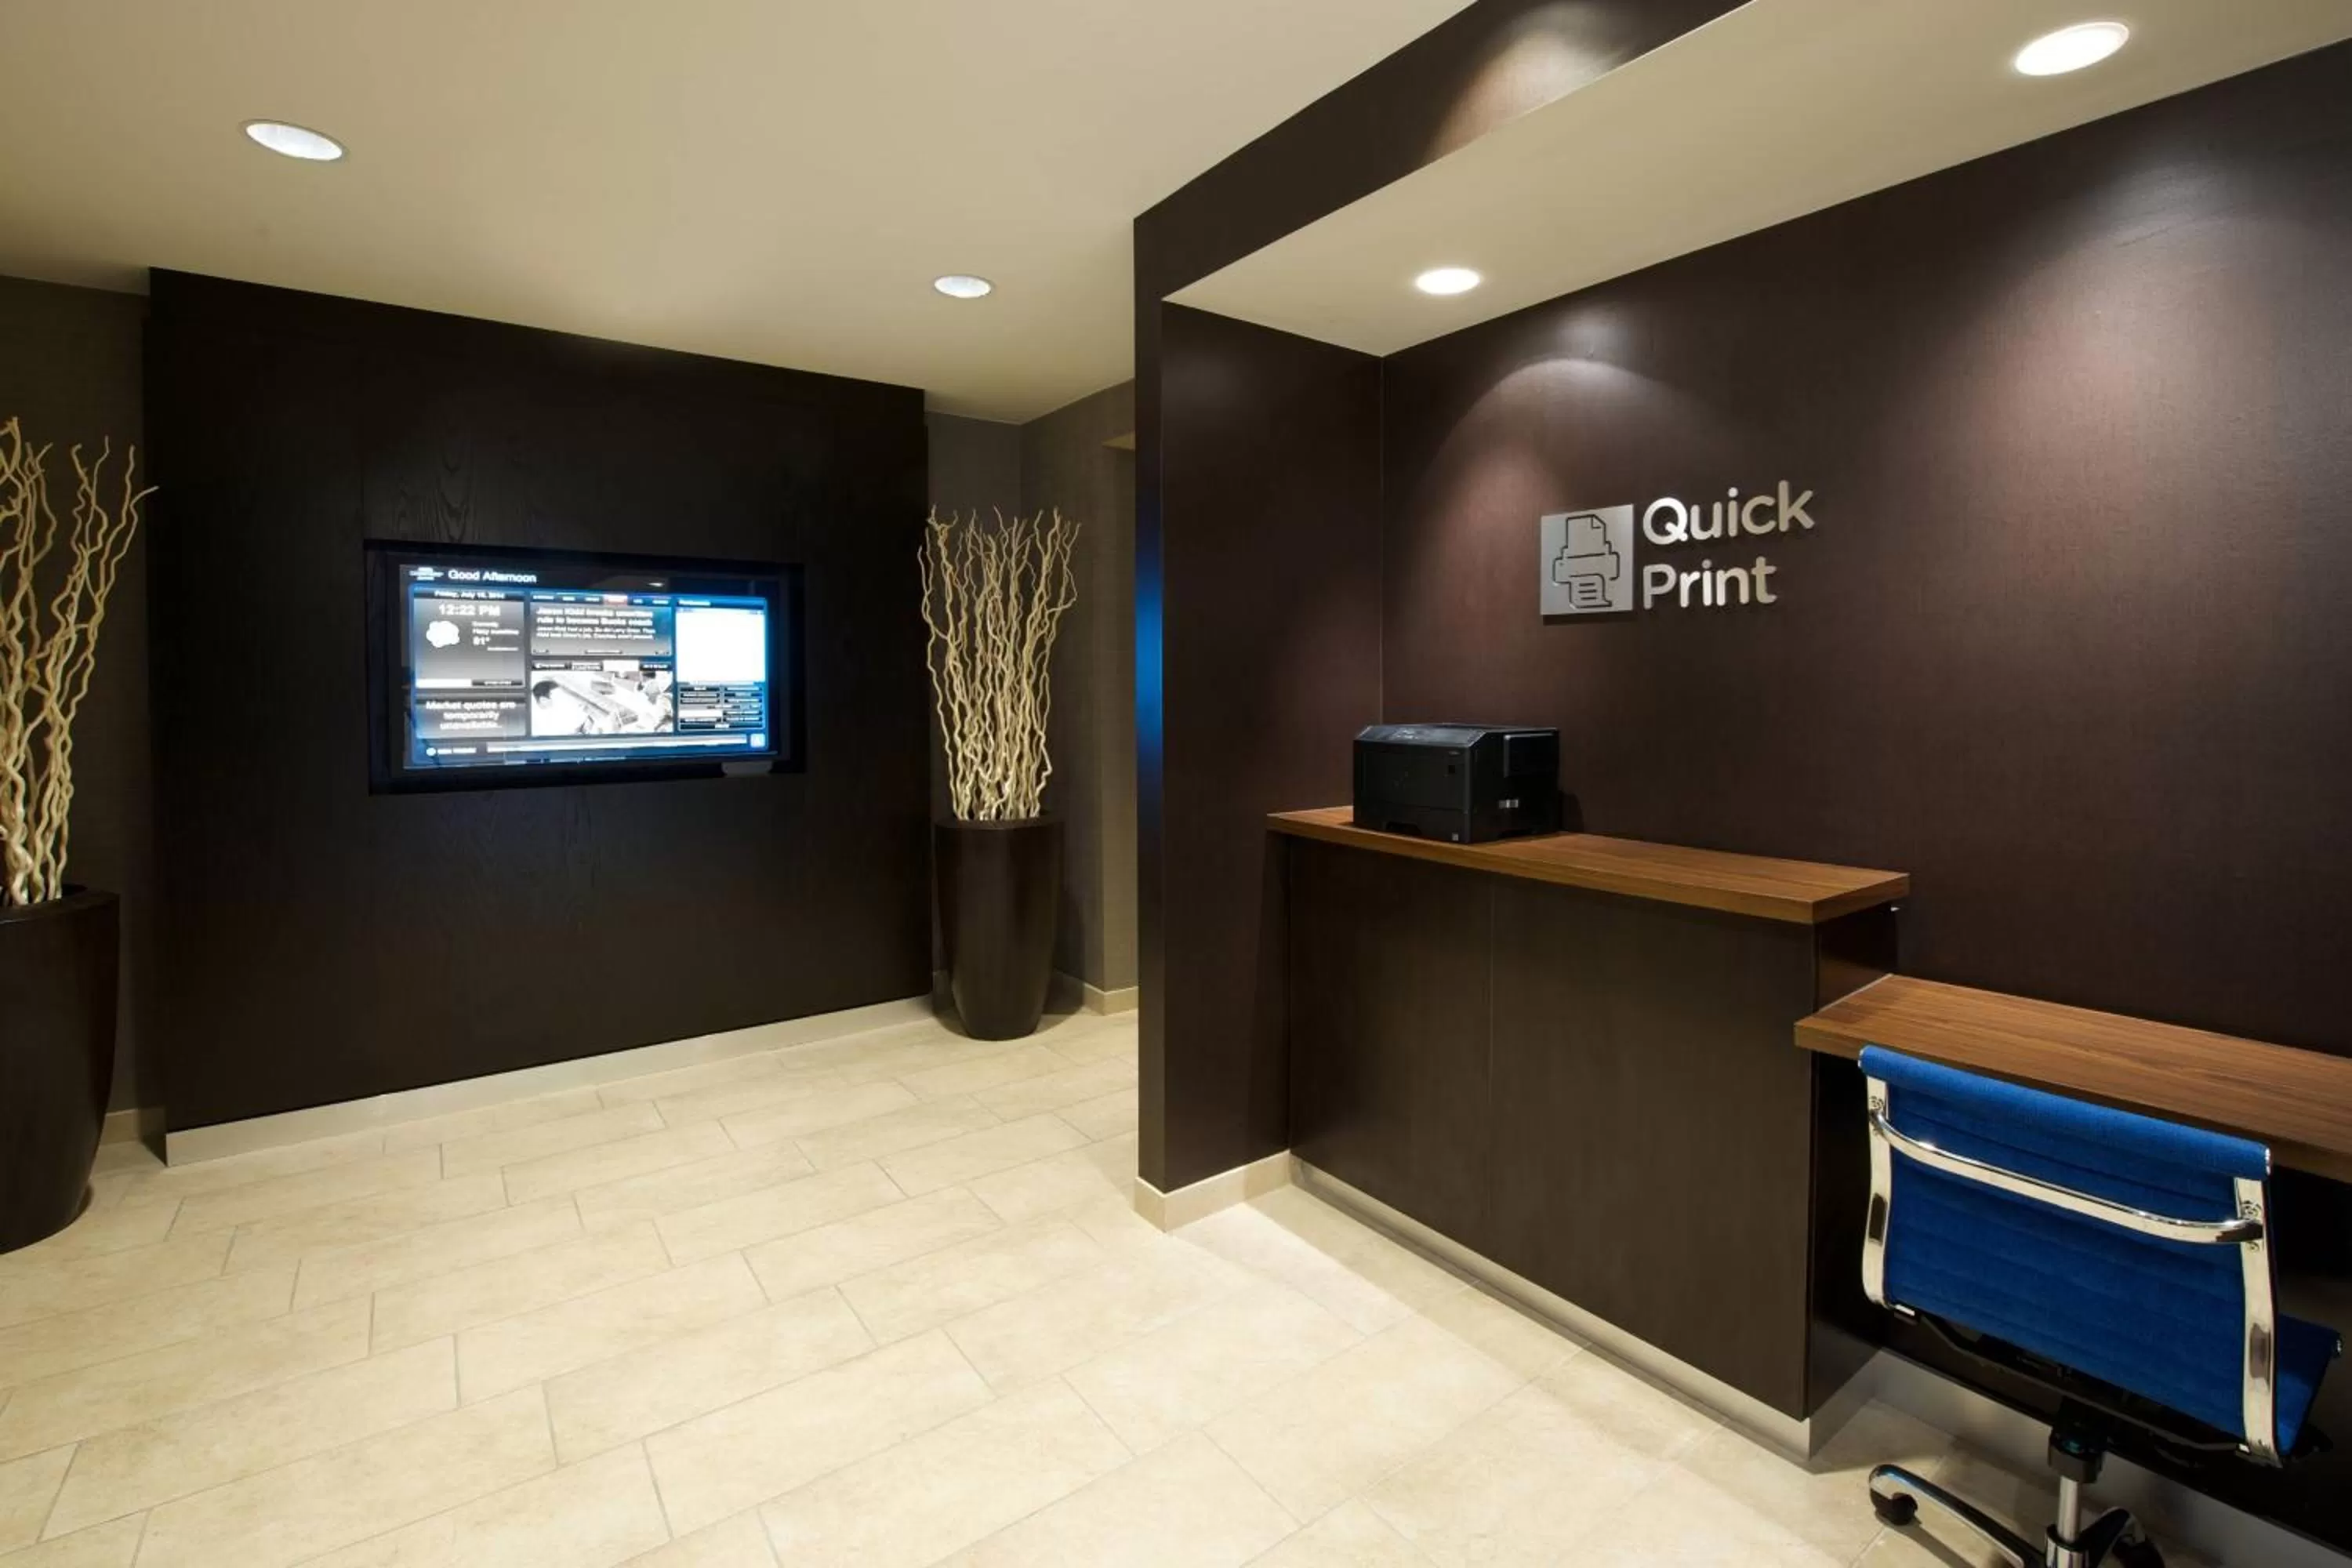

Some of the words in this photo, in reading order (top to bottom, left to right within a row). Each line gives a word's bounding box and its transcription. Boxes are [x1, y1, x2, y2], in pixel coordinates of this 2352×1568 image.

[1642, 480, 1815, 546] Quick
[448, 569, 481, 581] Good
[482, 571, 538, 583] Afternoon
[1642, 556, 1778, 611] Print
[438, 604, 476, 616] 12:22
[478, 604, 502, 617] PM
[426, 700, 462, 710] Market
[463, 700, 498, 711] quotes
[499, 701, 517, 710] are
